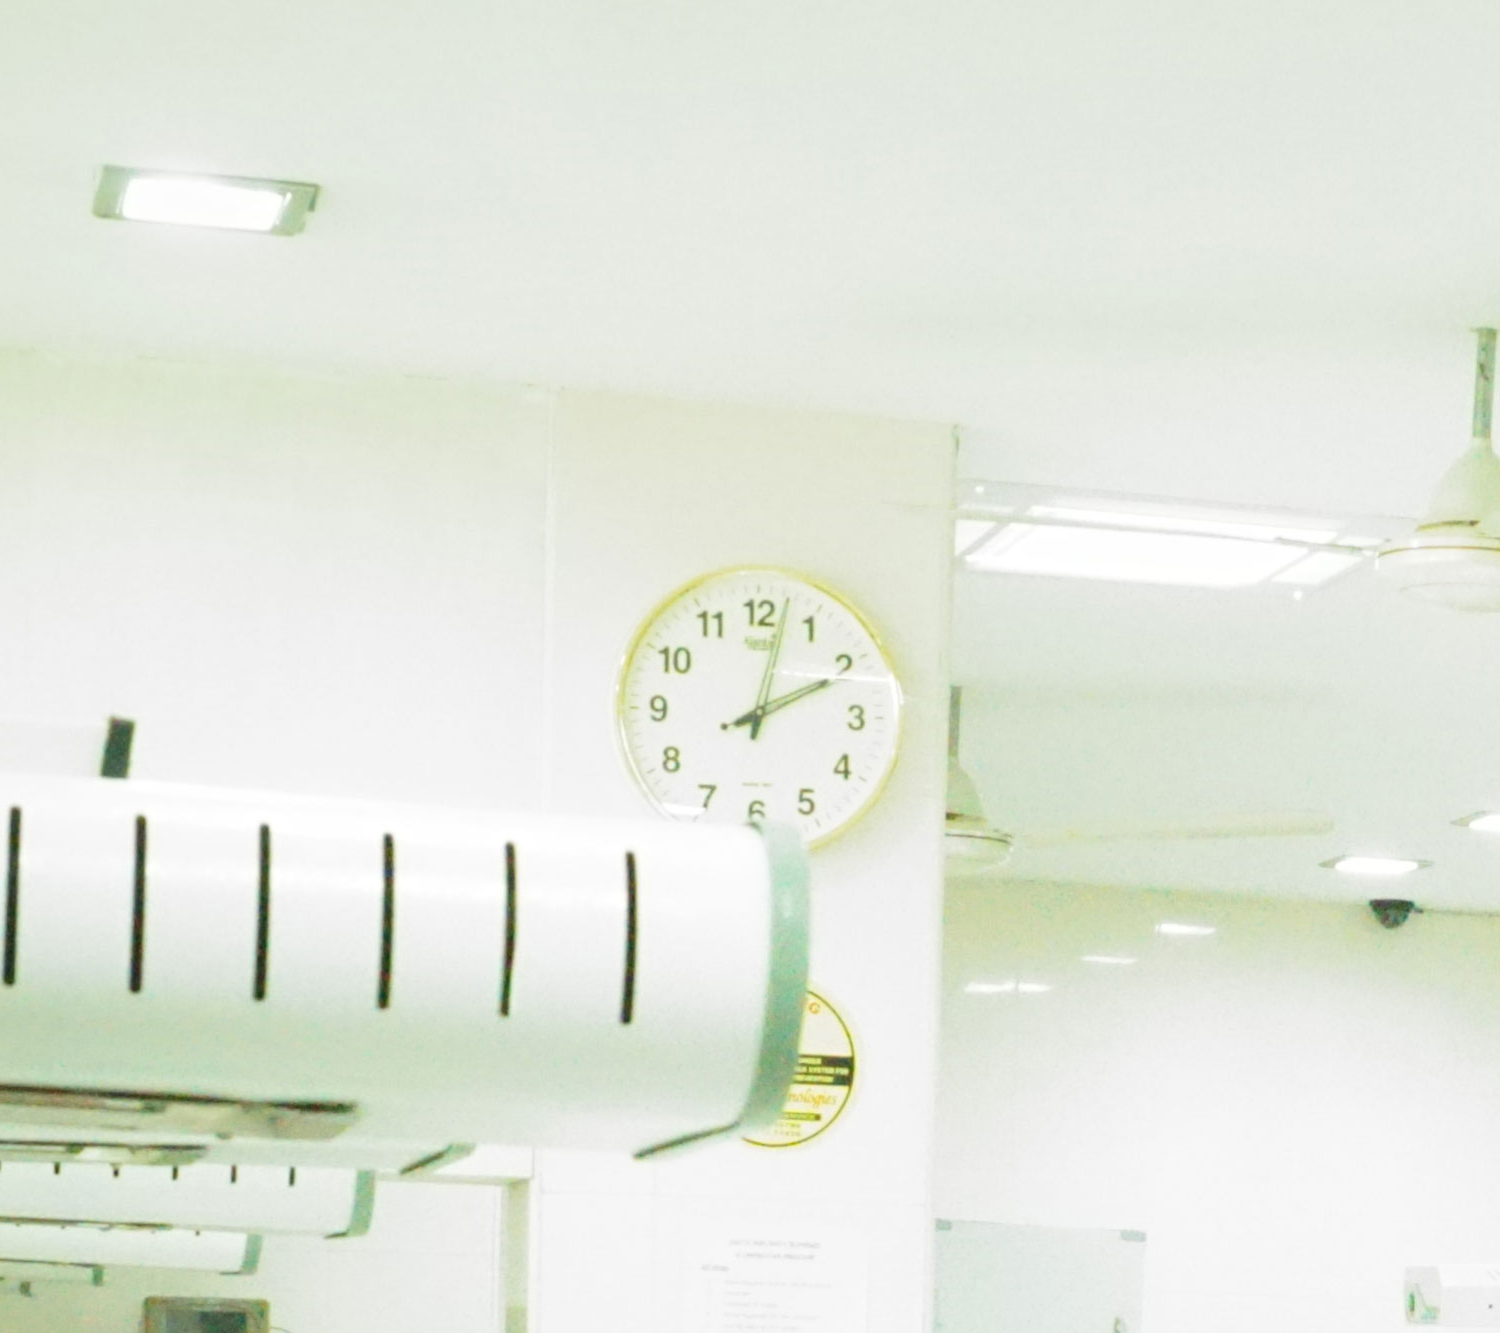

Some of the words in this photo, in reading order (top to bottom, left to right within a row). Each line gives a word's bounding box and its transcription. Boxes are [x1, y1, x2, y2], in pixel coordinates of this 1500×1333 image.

[697, 610, 725, 638] 11
[743, 599, 776, 627] 12
[802, 615, 815, 642] 1
[658, 646, 691, 674] 10
[835, 653, 853, 676] 2
[649, 694, 668, 722] 9
[847, 704, 865, 731] 3
[662, 746, 681, 773] 8
[833, 753, 852, 781] 4
[697, 783, 717, 810] 7
[748, 799, 766, 821] 6
[797, 788, 816, 816] 5
